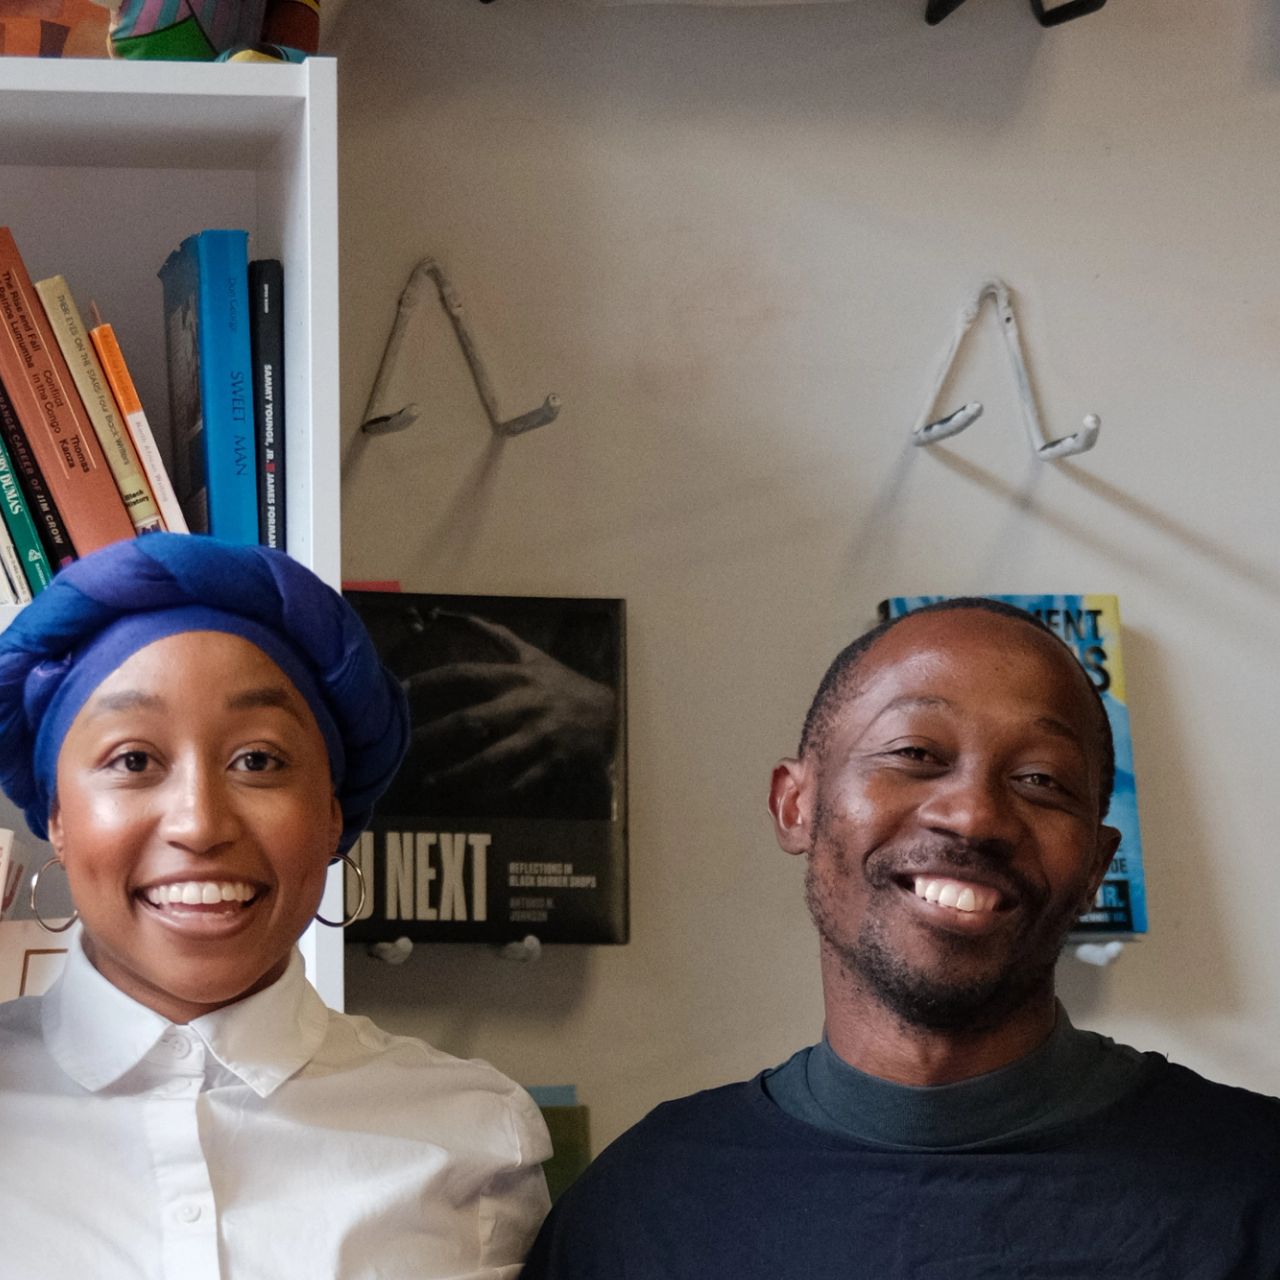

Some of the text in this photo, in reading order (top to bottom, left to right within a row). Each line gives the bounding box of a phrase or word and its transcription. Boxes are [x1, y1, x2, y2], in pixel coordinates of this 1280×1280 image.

[0, 269, 42, 352] The Rise and Fall
[8, 319, 36, 369] Lumumba
[30, 372, 63, 434] in the Congo
[41, 368, 66, 408] Conflict
[228, 370, 248, 476] SWEET MAN
[10, 432, 35, 474] CAREER
[35, 493, 50, 512] JIM
[44, 513, 64, 546] CROW
[57, 438, 77, 469] Kanza
[68, 433, 92, 474] Thomas
[262, 364, 277, 549] SAMMY YOUNGE, JR. JAMES FORMAN
[386, 831, 492, 922] NEXT
